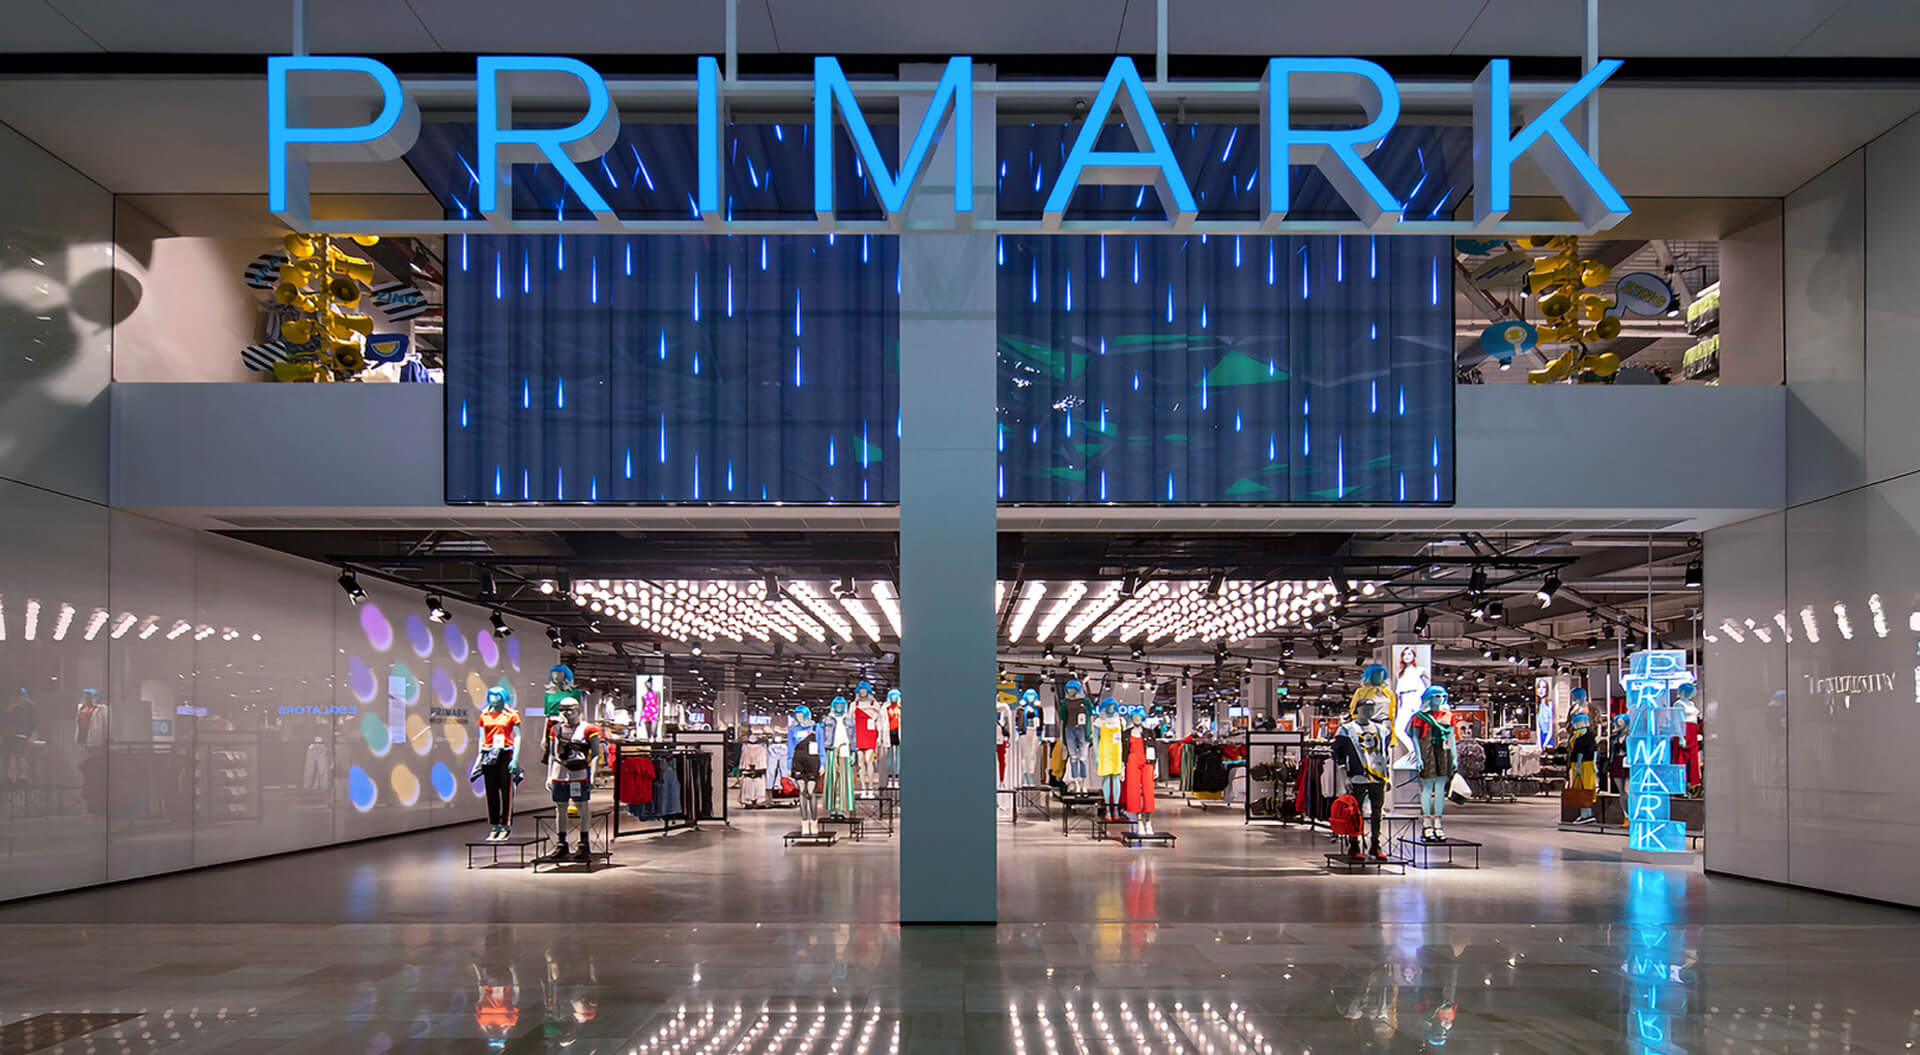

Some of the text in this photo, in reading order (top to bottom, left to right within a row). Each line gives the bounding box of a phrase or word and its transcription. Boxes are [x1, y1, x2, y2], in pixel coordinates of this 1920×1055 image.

[267, 55, 1632, 214] PRIMARK
[376, 291, 416, 305] ZING
[1622, 281, 1665, 307] ZING
[430, 707, 468, 717] PRIMARK
[1633, 655, 1676, 850] PRIMARK
